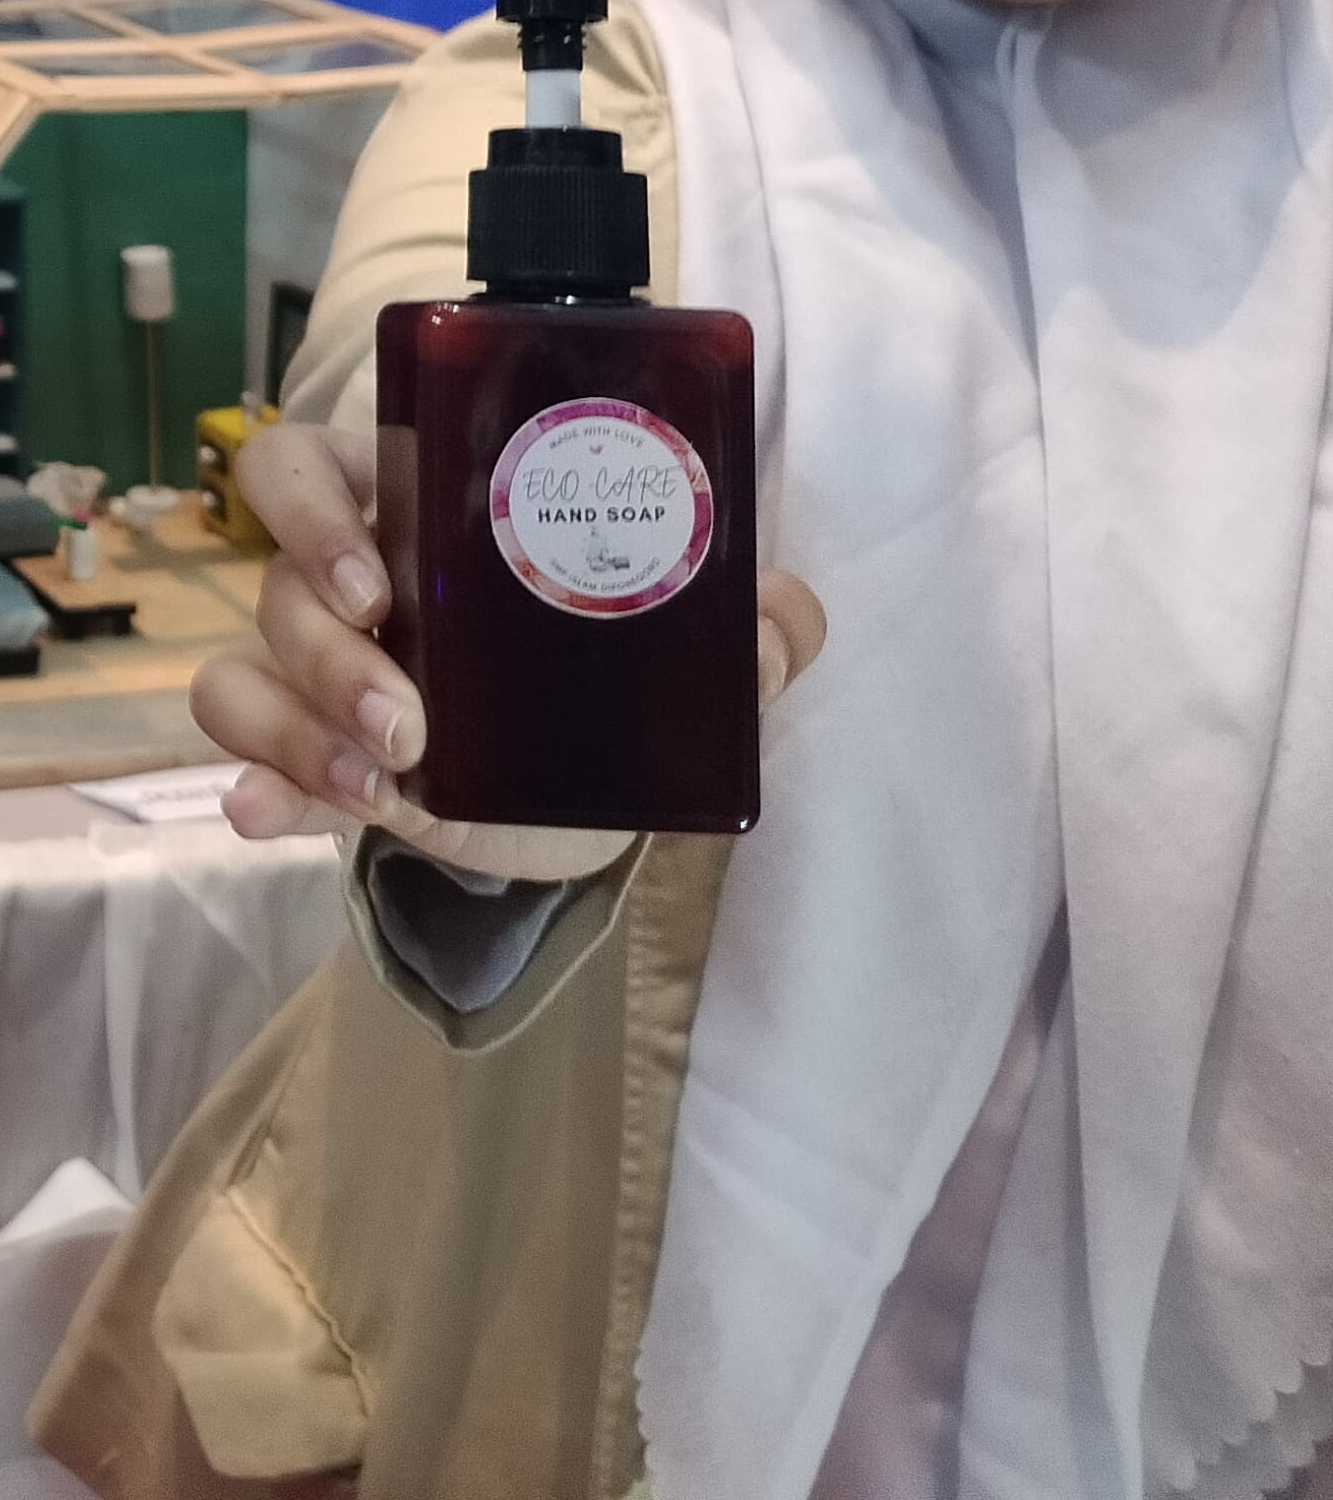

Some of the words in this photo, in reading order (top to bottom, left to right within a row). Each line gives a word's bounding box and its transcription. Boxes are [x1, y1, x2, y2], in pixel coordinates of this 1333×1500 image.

[523, 466, 579, 501] ECO
[595, 465, 680, 502] CARE
[538, 508, 597, 523] HAND
[606, 506, 665, 522] SOAP
